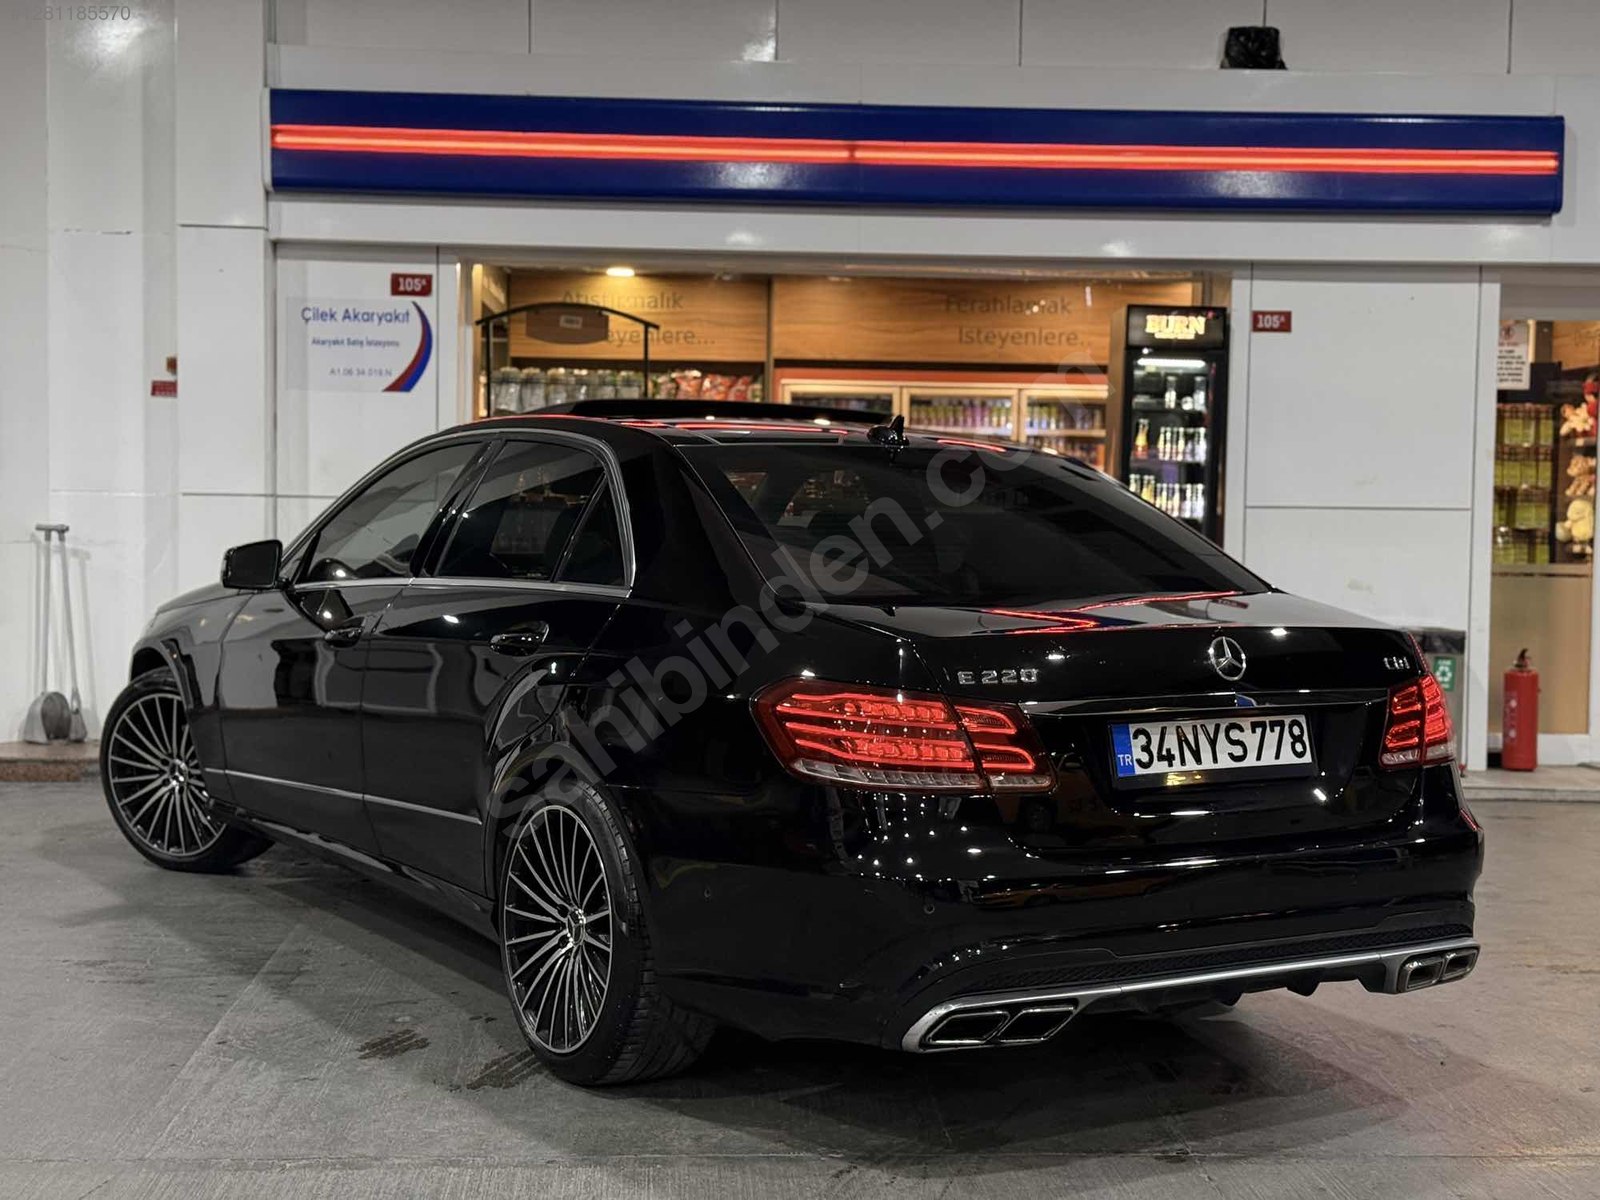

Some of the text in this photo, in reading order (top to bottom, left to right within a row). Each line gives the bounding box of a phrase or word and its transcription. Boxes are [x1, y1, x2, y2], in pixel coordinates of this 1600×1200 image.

[301, 307, 410, 325] Çilek Akaryakıt
[1145, 314, 1206, 335] BURN
[981, 668, 1039, 684] 220
[1117, 754, 1133, 767] TR
